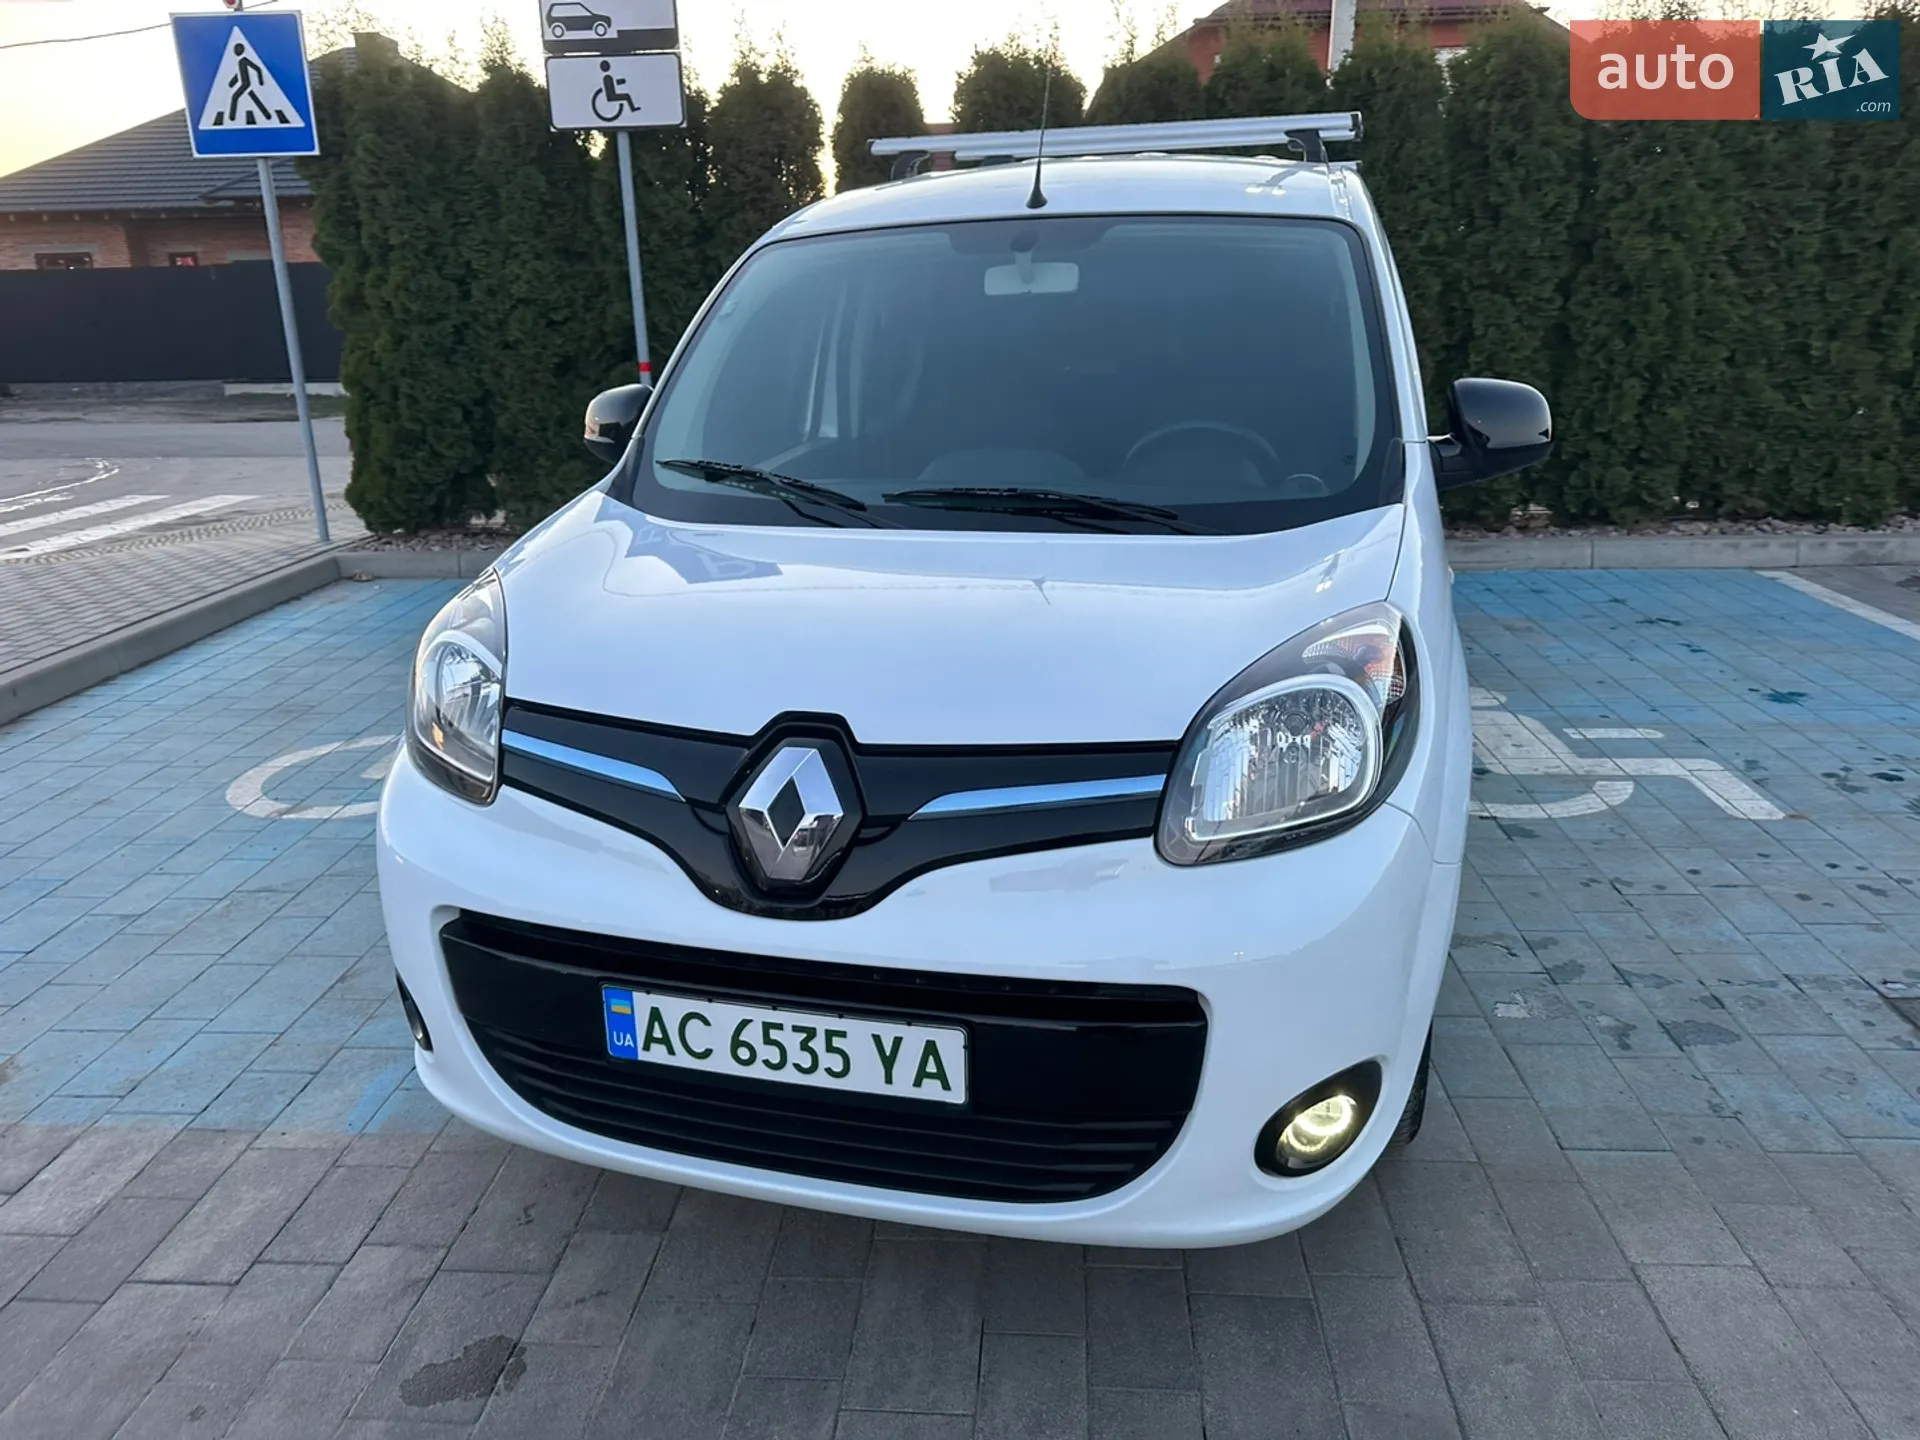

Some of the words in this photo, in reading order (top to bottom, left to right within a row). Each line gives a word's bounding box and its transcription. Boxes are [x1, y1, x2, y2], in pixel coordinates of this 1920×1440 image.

[613, 1031, 634, 1048] UA
[642, 1006, 714, 1060] AC
[729, 1018, 851, 1079] 6535
[871, 1033, 953, 1091] YA
